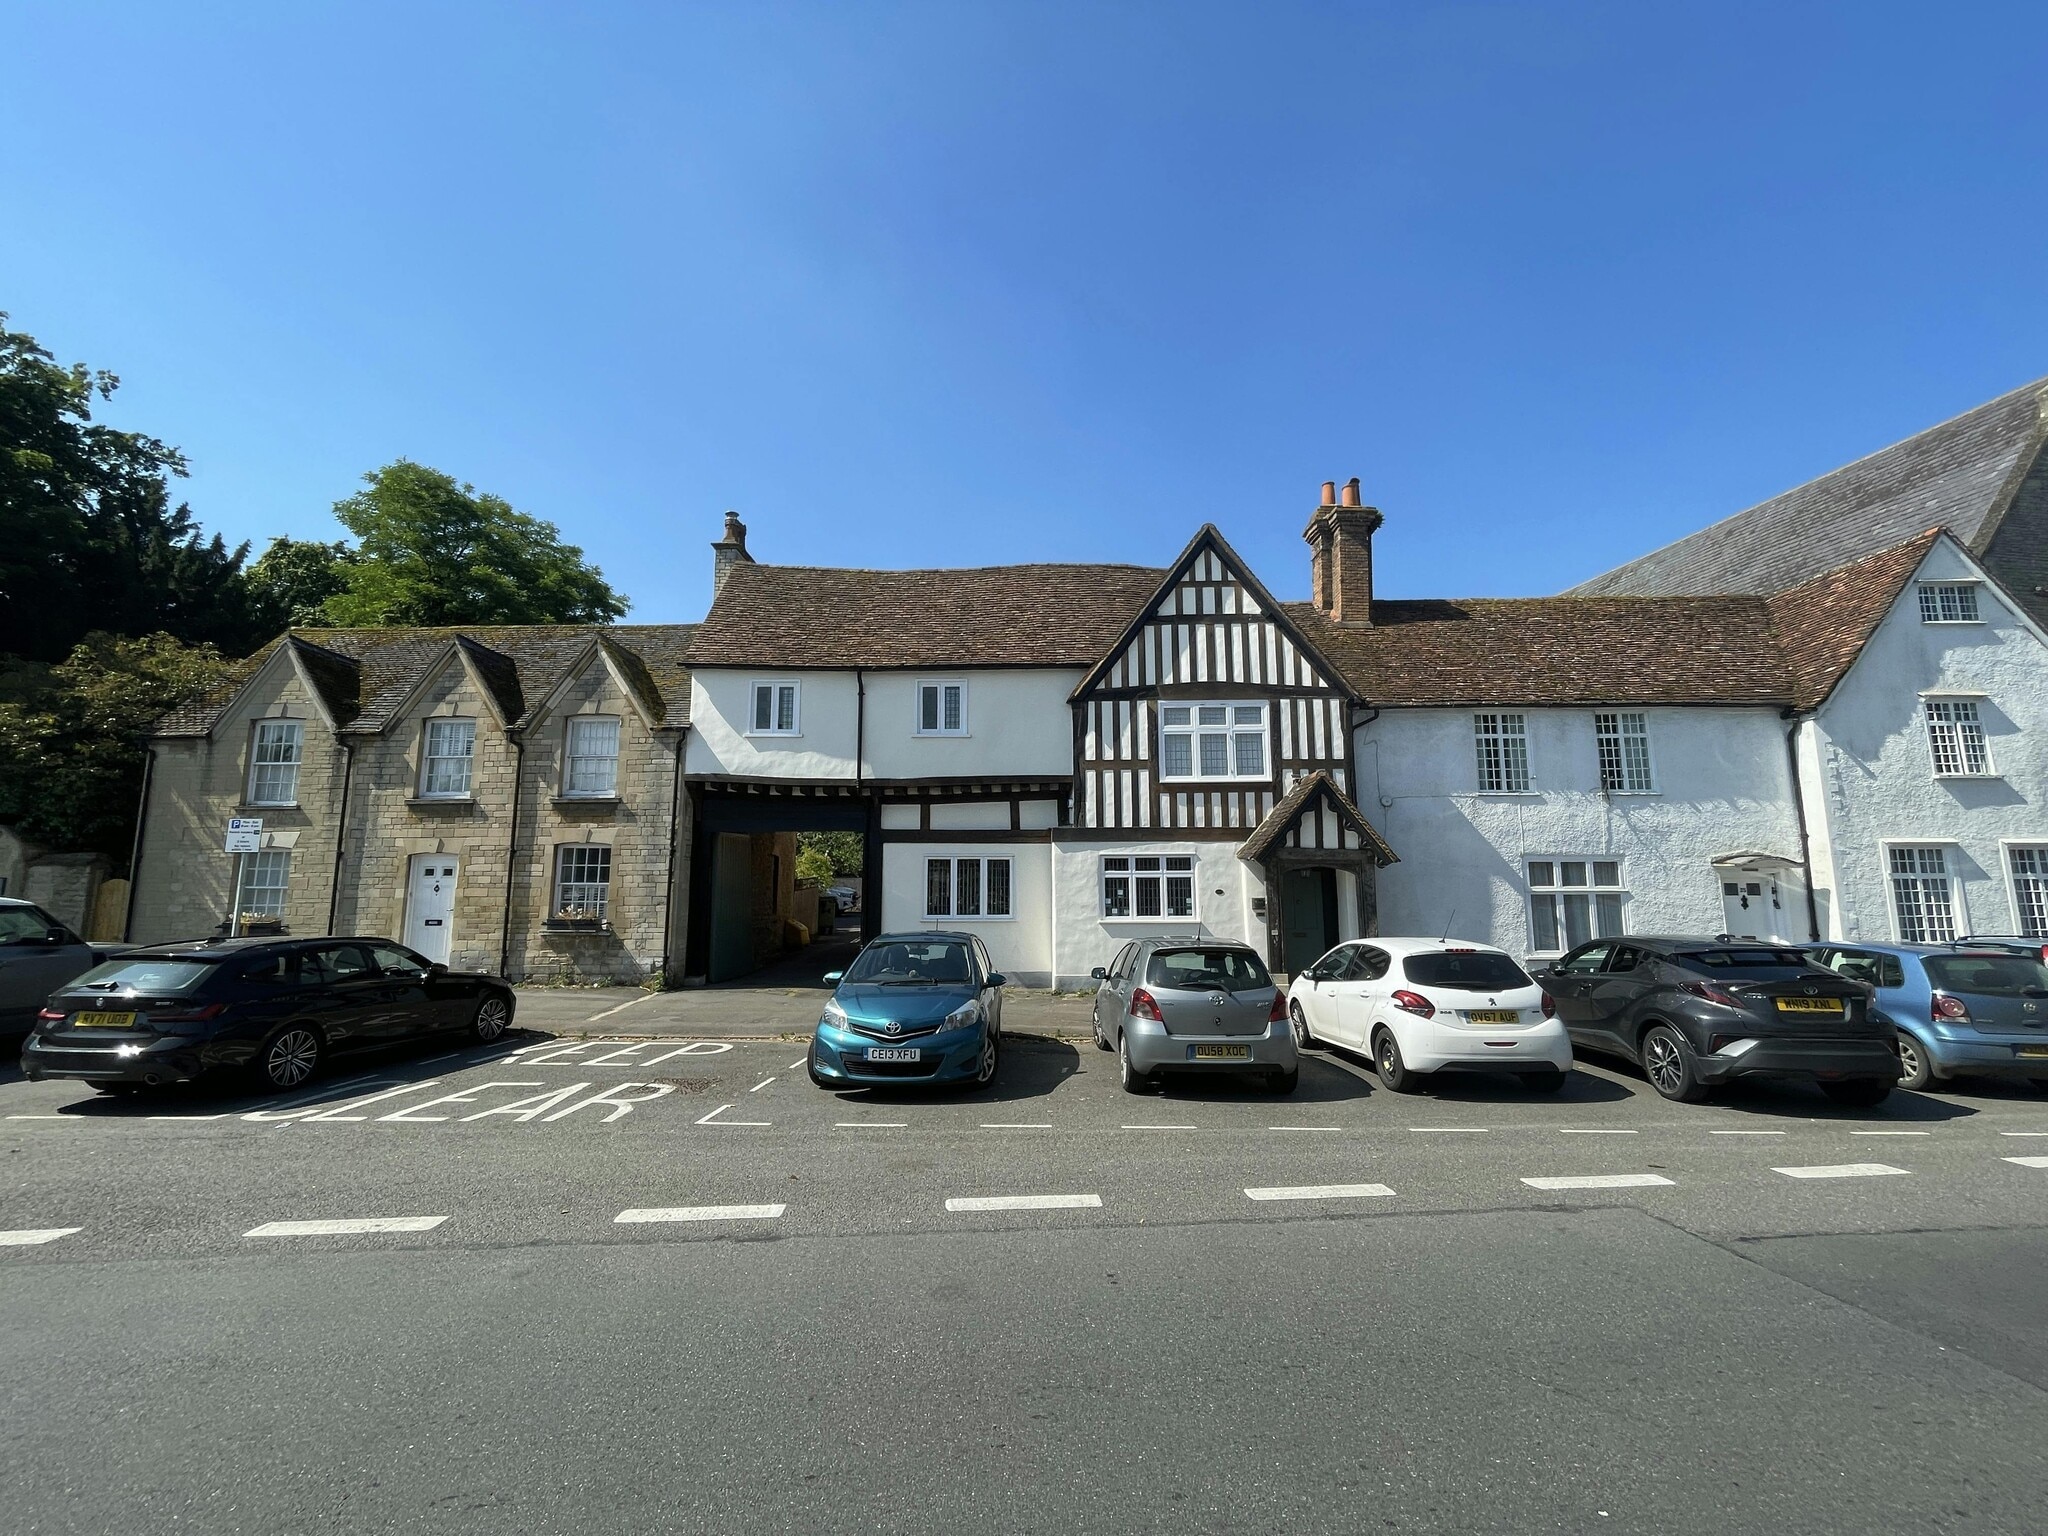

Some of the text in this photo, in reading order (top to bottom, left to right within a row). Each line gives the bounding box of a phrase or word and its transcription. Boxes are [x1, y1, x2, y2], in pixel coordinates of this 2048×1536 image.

[1813, 999, 1836, 1009] XNL
[82, 1013, 106, 1025] RV71
[1470, 1012, 1518, 1022] OV67 AUF
[501, 1041, 734, 1067] KEEP
[871, 1049, 917, 1060] CE13 XFU
[1197, 1046, 1245, 1056] OU58 XOC
[240, 1081, 678, 1122] CLEAR
